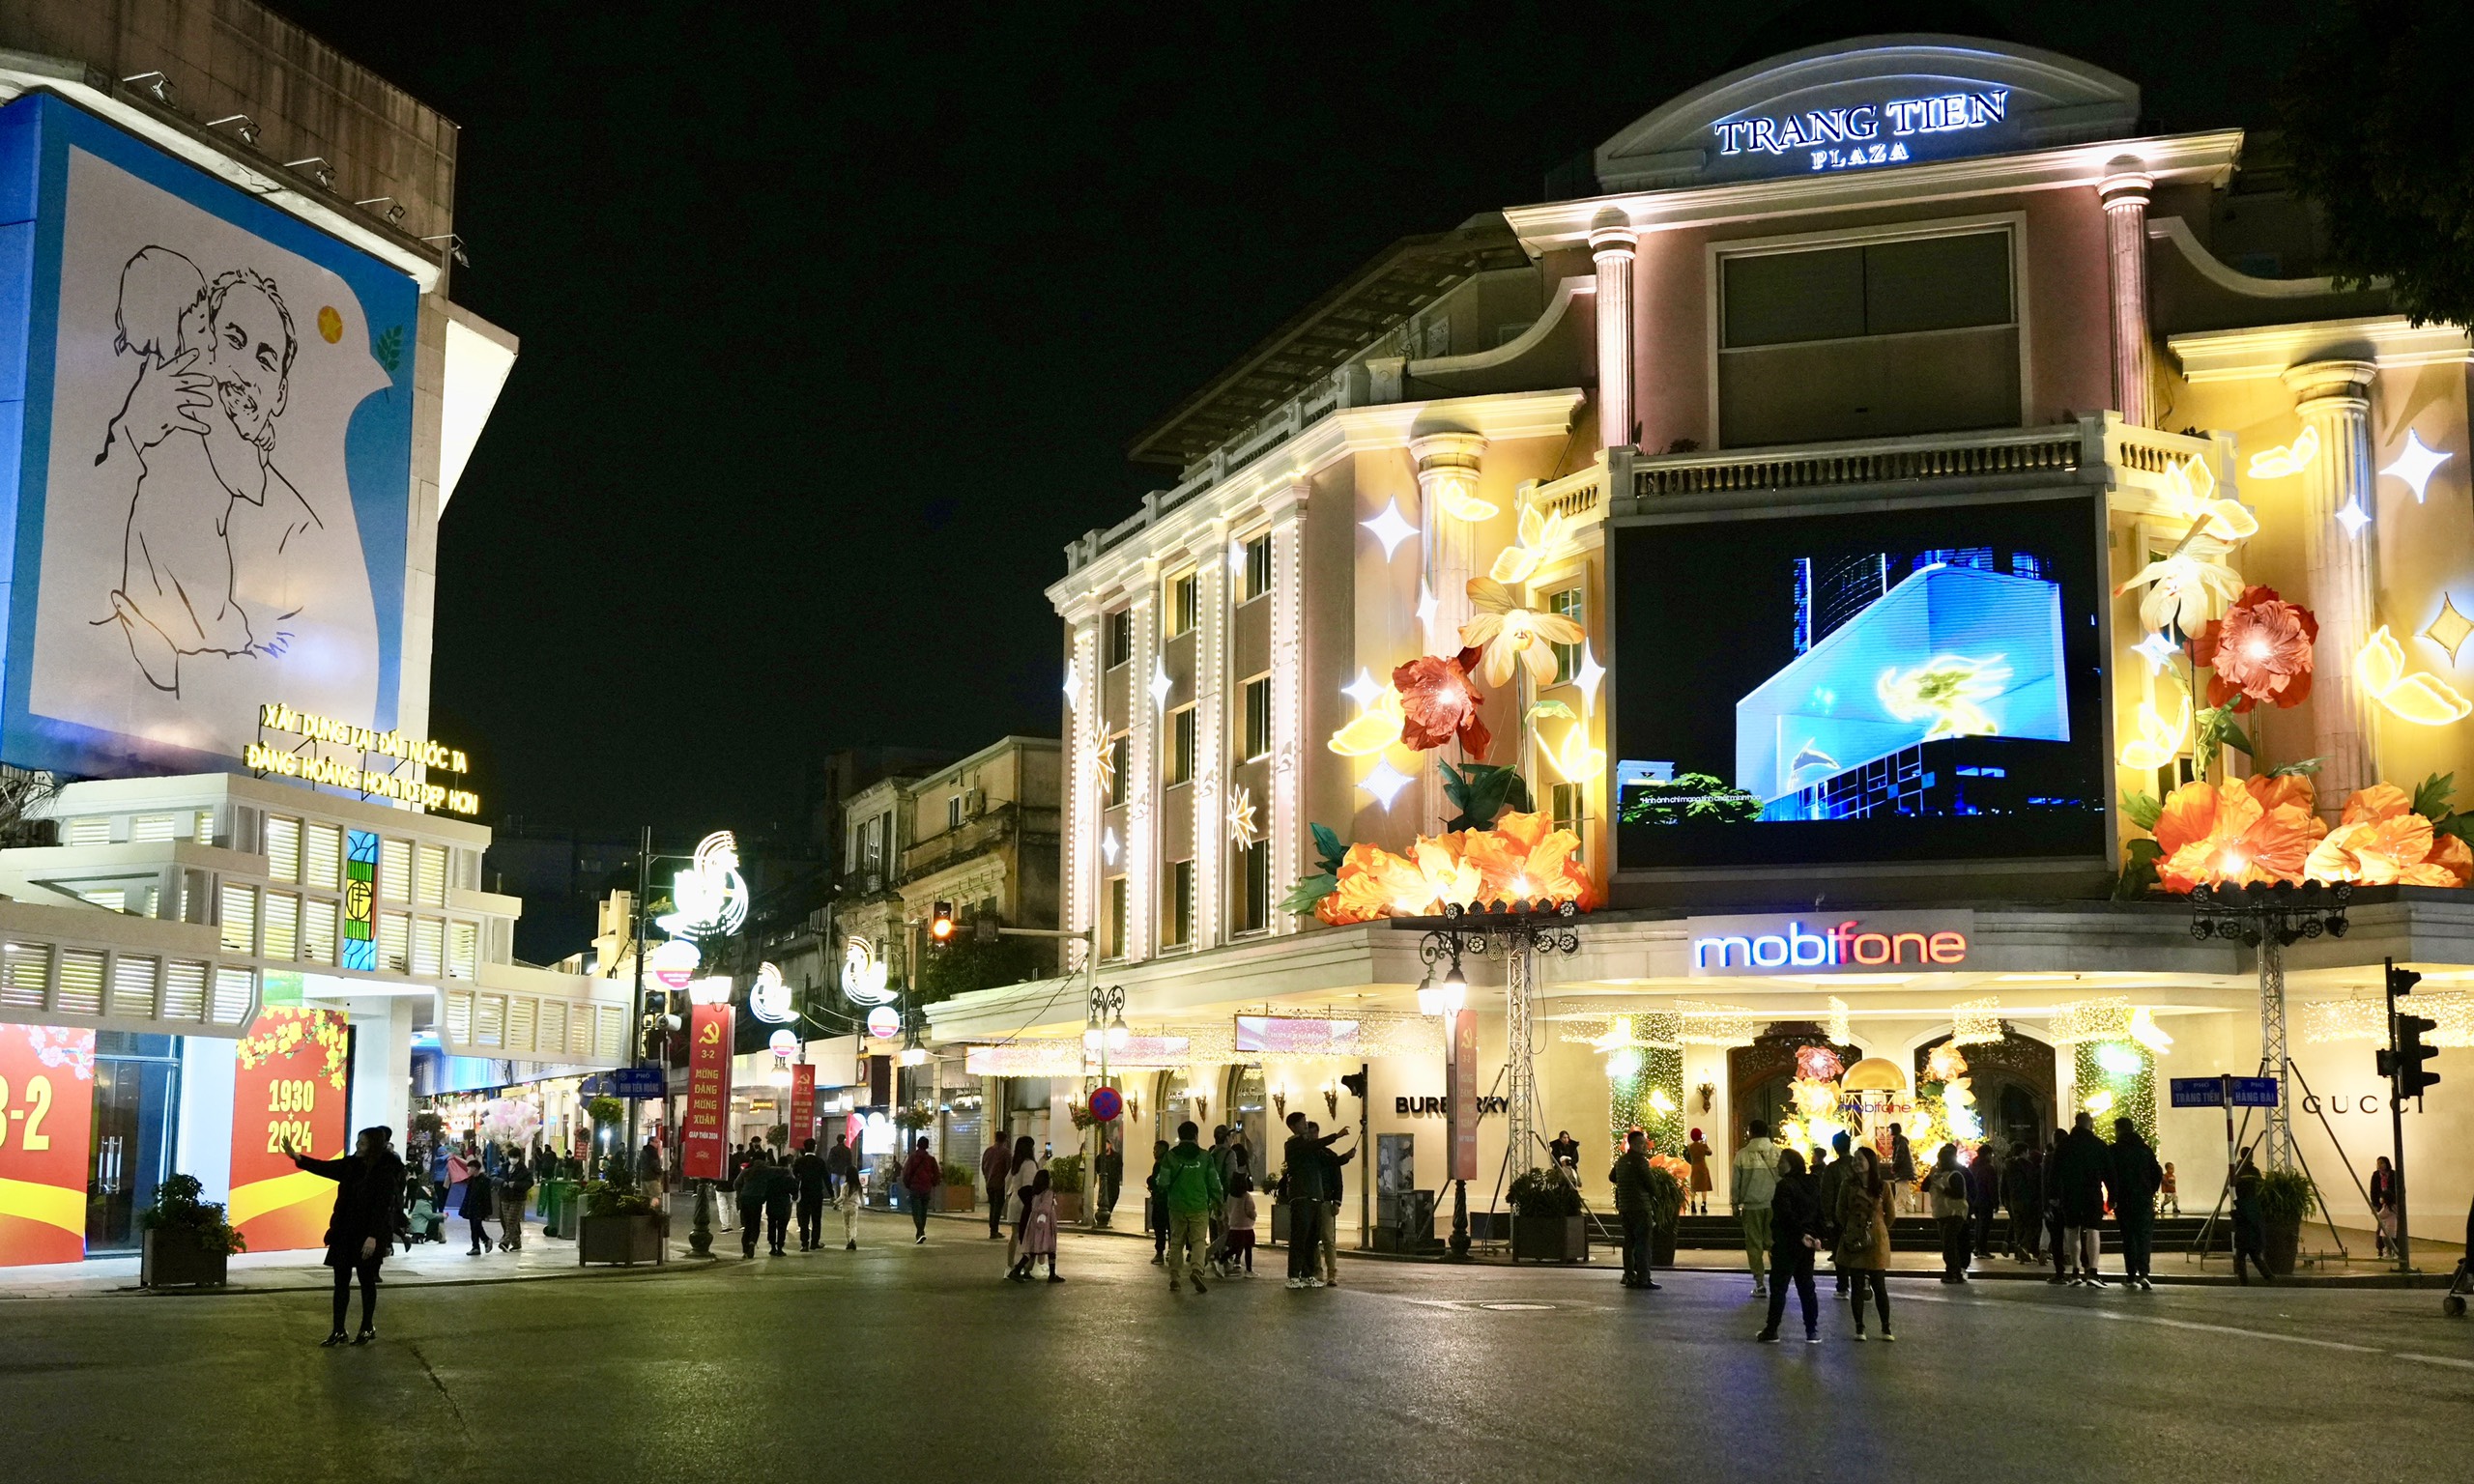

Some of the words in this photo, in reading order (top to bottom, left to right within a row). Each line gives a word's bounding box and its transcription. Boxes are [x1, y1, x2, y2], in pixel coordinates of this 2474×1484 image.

[1714, 104, 1879, 156] TRANG
[1885, 90, 2008, 135] TIEN
[1810, 142, 1911, 170] PLAZA
[263, 702, 298, 732] XÂY
[451, 750, 468, 774] TA
[247, 741, 297, 776] ĐÀNG
[302, 756, 358, 788] HOÀNG
[420, 784, 446, 811] ĐẸP
[1694, 921, 1968, 968] mobifone
[701, 1049, 715, 1059] 3-2
[268, 1078, 315, 1112] 1930
[1395, 1096, 1509, 1114] BURRY
[267, 1120, 313, 1154] 2024
[693, 1114, 716, 1126] XUÂN
